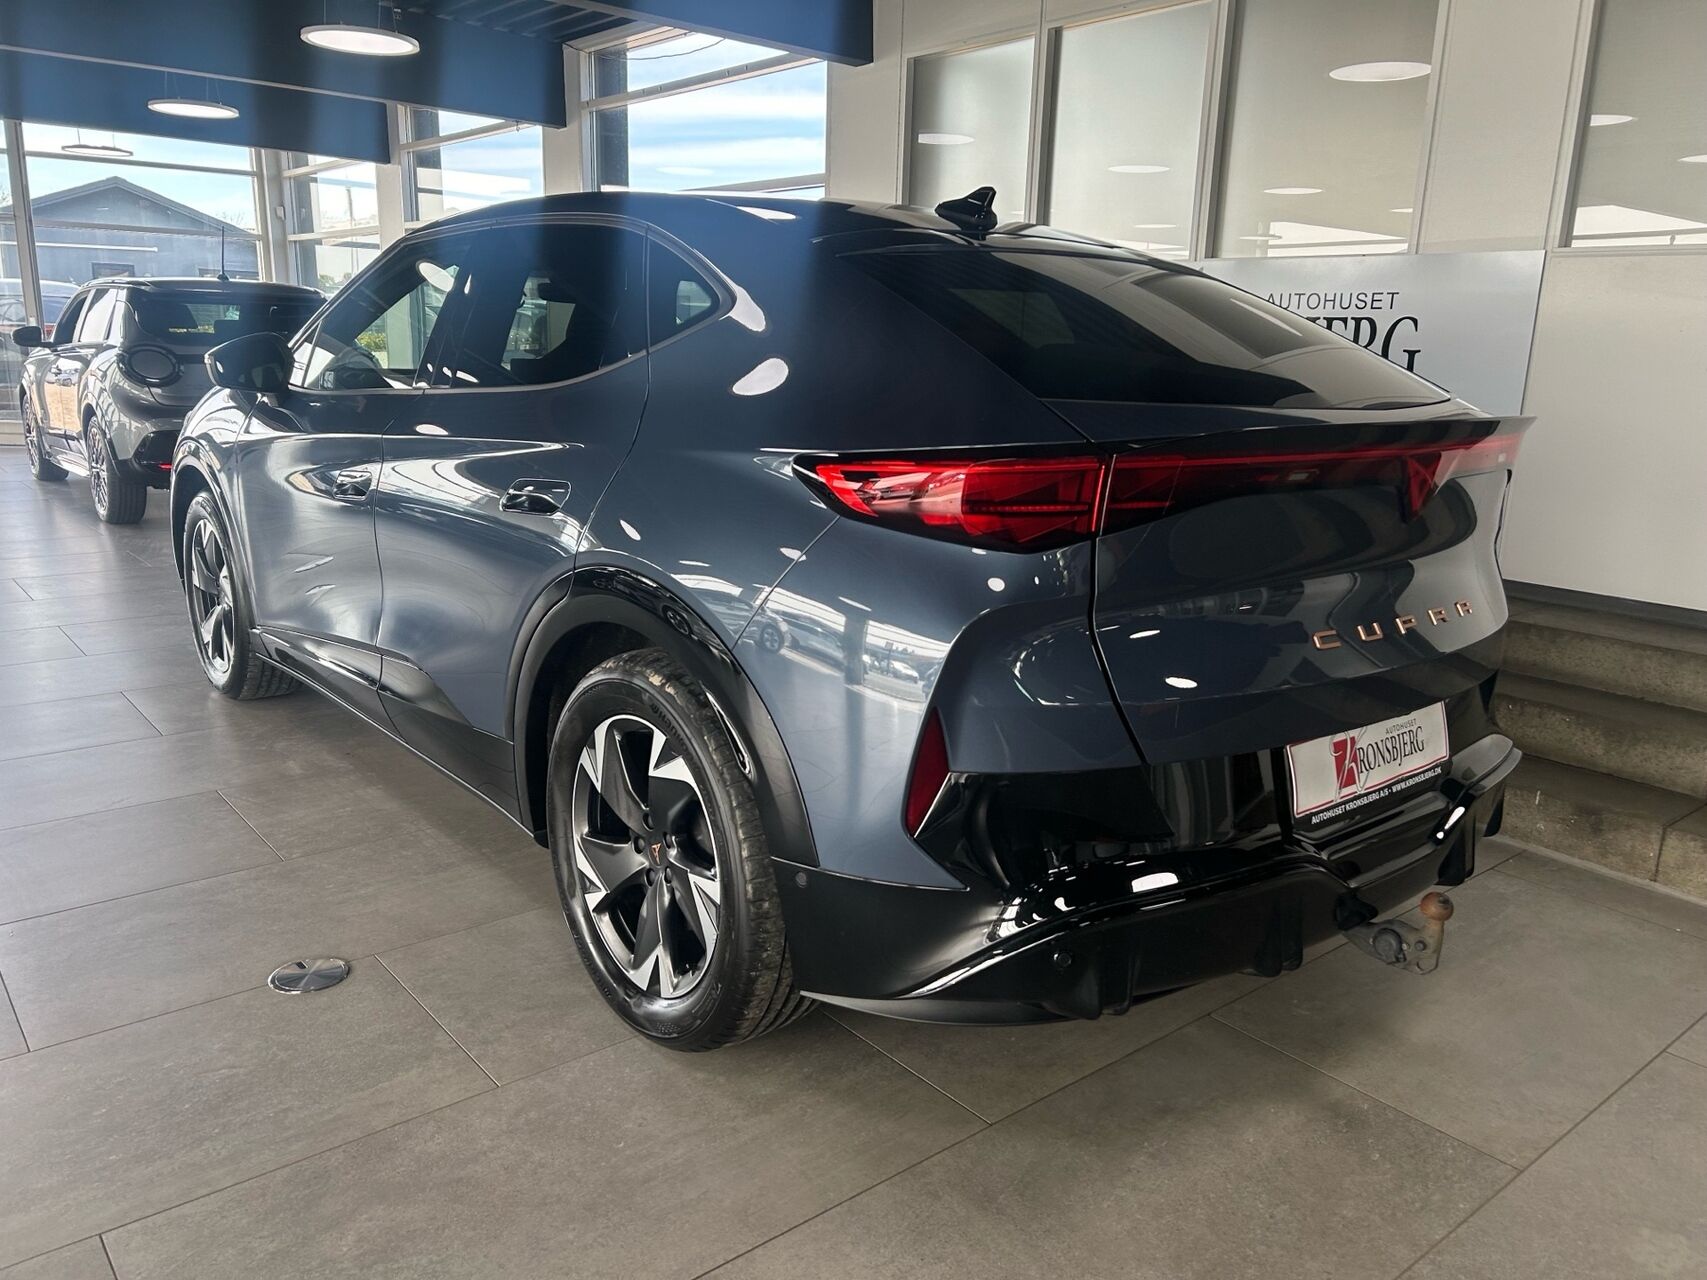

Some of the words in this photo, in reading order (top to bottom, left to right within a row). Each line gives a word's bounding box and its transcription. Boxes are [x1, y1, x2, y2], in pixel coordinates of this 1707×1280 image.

[1267, 292, 1400, 310] AUTOHUSET
[1312, 600, 1474, 651] CUPRA
[1385, 718, 1417, 735] AUTOHUSET
[1331, 727, 1425, 801] KRONSBJERG
[1311, 805, 1345, 824] AUTOHUSET
[1346, 792, 1380, 812] KRONSBJERG
[1380, 788, 1389, 799] A/S
[1392, 766, 1442, 793] WWW.KRONSBJERG.DK
